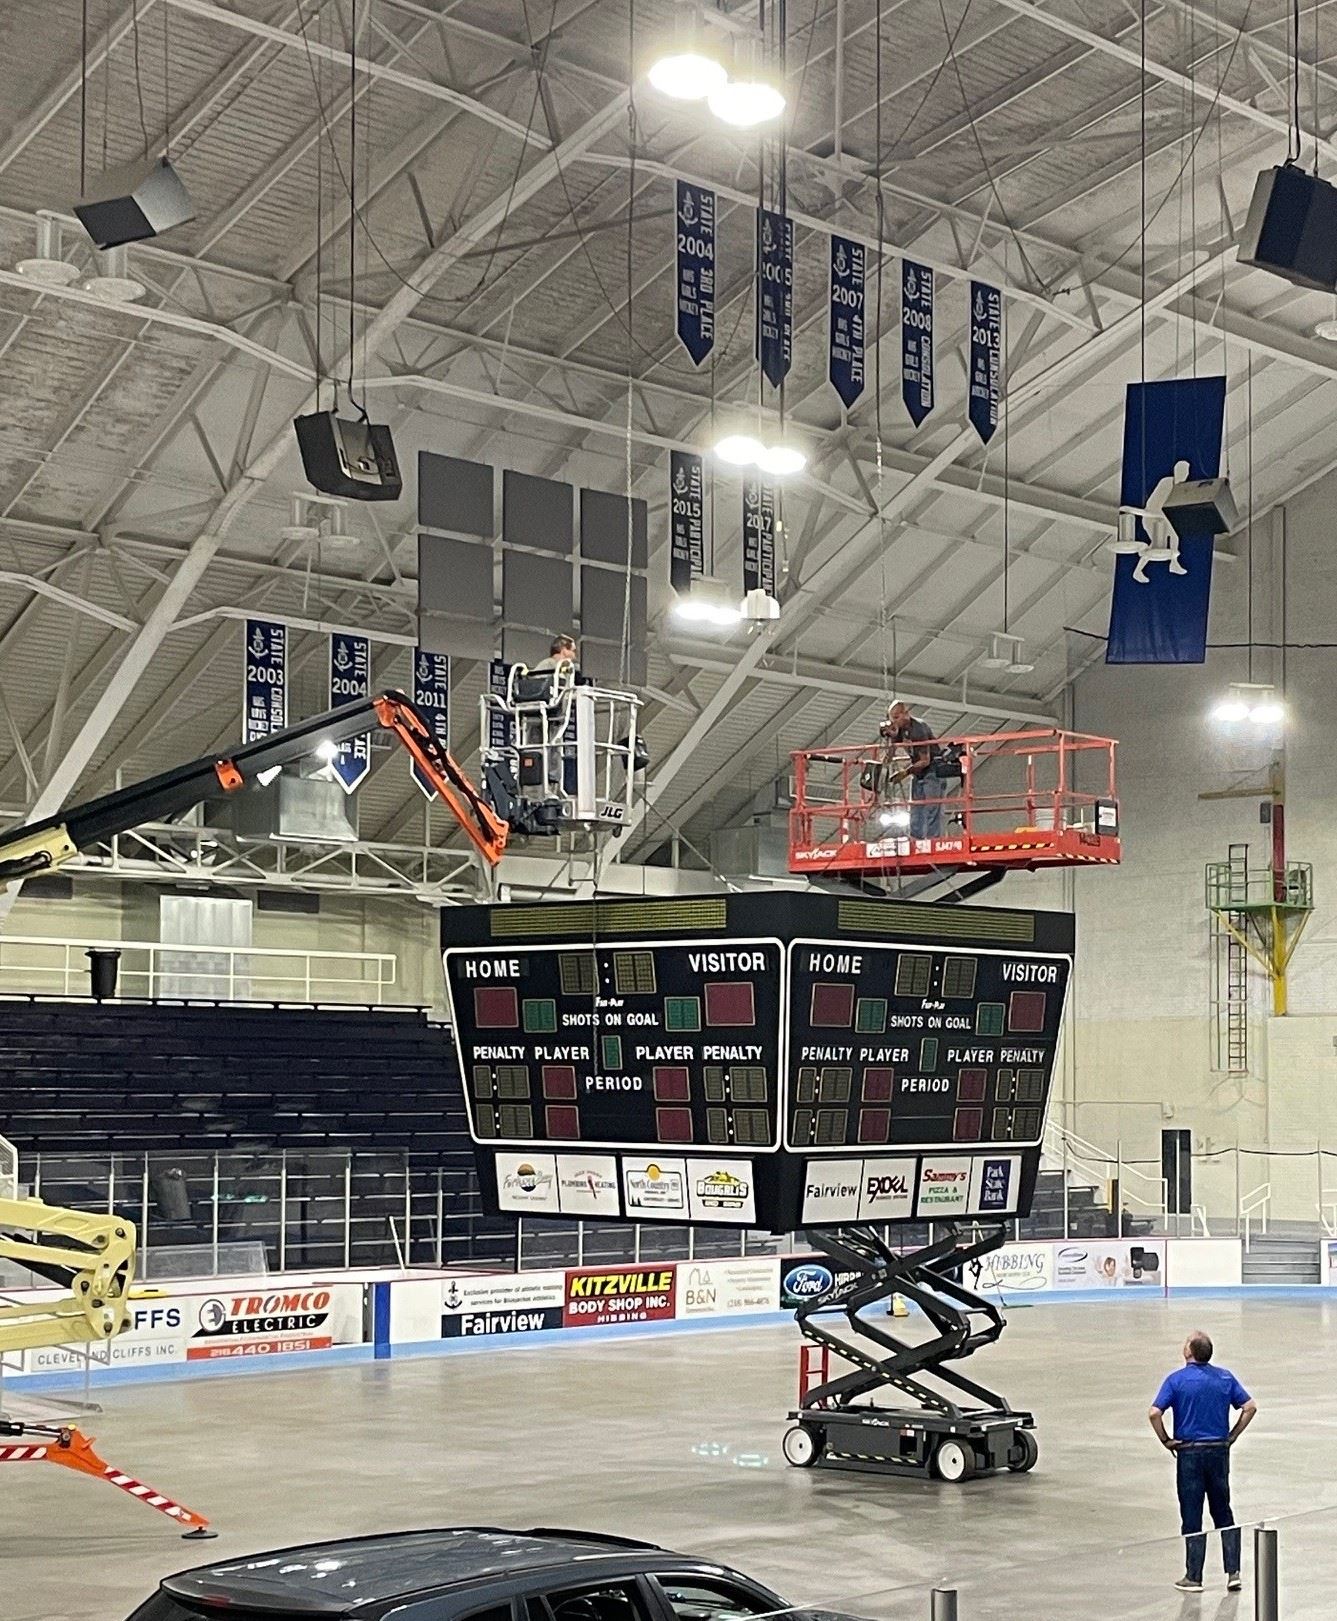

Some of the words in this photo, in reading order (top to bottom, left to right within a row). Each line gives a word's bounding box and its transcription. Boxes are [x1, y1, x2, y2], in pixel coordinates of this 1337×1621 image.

[700, 194, 714, 237] STATE
[678, 233, 714, 261] 2004
[851, 247, 864, 286] STATE
[700, 267, 714, 294] 3RD
[921, 270, 933, 309] STATE
[832, 284, 864, 310] 2007
[700, 300, 714, 340] PLACE
[902, 307, 932, 333] 2008
[988, 293, 1000, 329] STATE
[851, 314, 864, 341] 4TH
[972, 327, 1000, 349] 2013
[851, 344, 864, 382] PLACE
[921, 335, 932, 408] CONSOLATION
[690, 465, 702, 502] STATE
[672, 499, 702, 518] 2015
[270, 628, 285, 665] STATE
[353, 641, 368, 678] STATE
[247, 665, 285, 686] 2003
[433, 654, 448, 691] STATE
[331, 678, 368, 697] 2004
[415, 689, 448, 709] 2011
[434, 712, 448, 736] 4TH
[600, 806, 625, 819] JLG
[795, 849, 838, 860] SKYJACK
[465, 959, 521, 980] HOME
[689, 951, 766, 974] VISITOR
[809, 952, 863, 975] HOME
[1001, 962, 1059, 984] VISITOR
[561, 1013, 600, 1027] SHOTS
[605, 1013, 622, 1026] ON
[626, 1013, 660, 1026] GOAL
[890, 1015, 924, 1028] SHOTS
[928, 1016, 942, 1028] ON
[945, 1016, 972, 1030] GOAL
[472, 1046, 525, 1060] PENALTY
[533, 1046, 590, 1061] PLAYER
[635, 1046, 693, 1061] PLAYER
[703, 1046, 763, 1061] PENALTY
[801, 1046, 853, 1060] PENALTY
[859, 1048, 909, 1063] PLAYER
[946, 1049, 994, 1063] PLAYER
[999, 1050, 1045, 1063] PENALTY
[585, 1076, 643, 1091] PERIOD
[900, 1078, 950, 1093] PERIOD
[806, 1182, 858, 1199] Fairview
[570, 1271, 673, 1297] KITZVILLE
[792, 1270, 824, 1293] Ford
[230, 1291, 330, 1317] TROMCO
[568, 1300, 605, 1315] BODY
[608, 1298, 643, 1312] SHOP
[646, 1295, 670, 1309] INC.
[686, 1288, 716, 1305] B&N
[231, 1314, 317, 1334] ELECTRIC
[461, 1309, 545, 1336] Fairview
[597, 1312, 647, 1323] HIBBING
[37, 1349, 107, 1366] CLEVELND
[112, 1345, 153, 1359] CLIFFS
